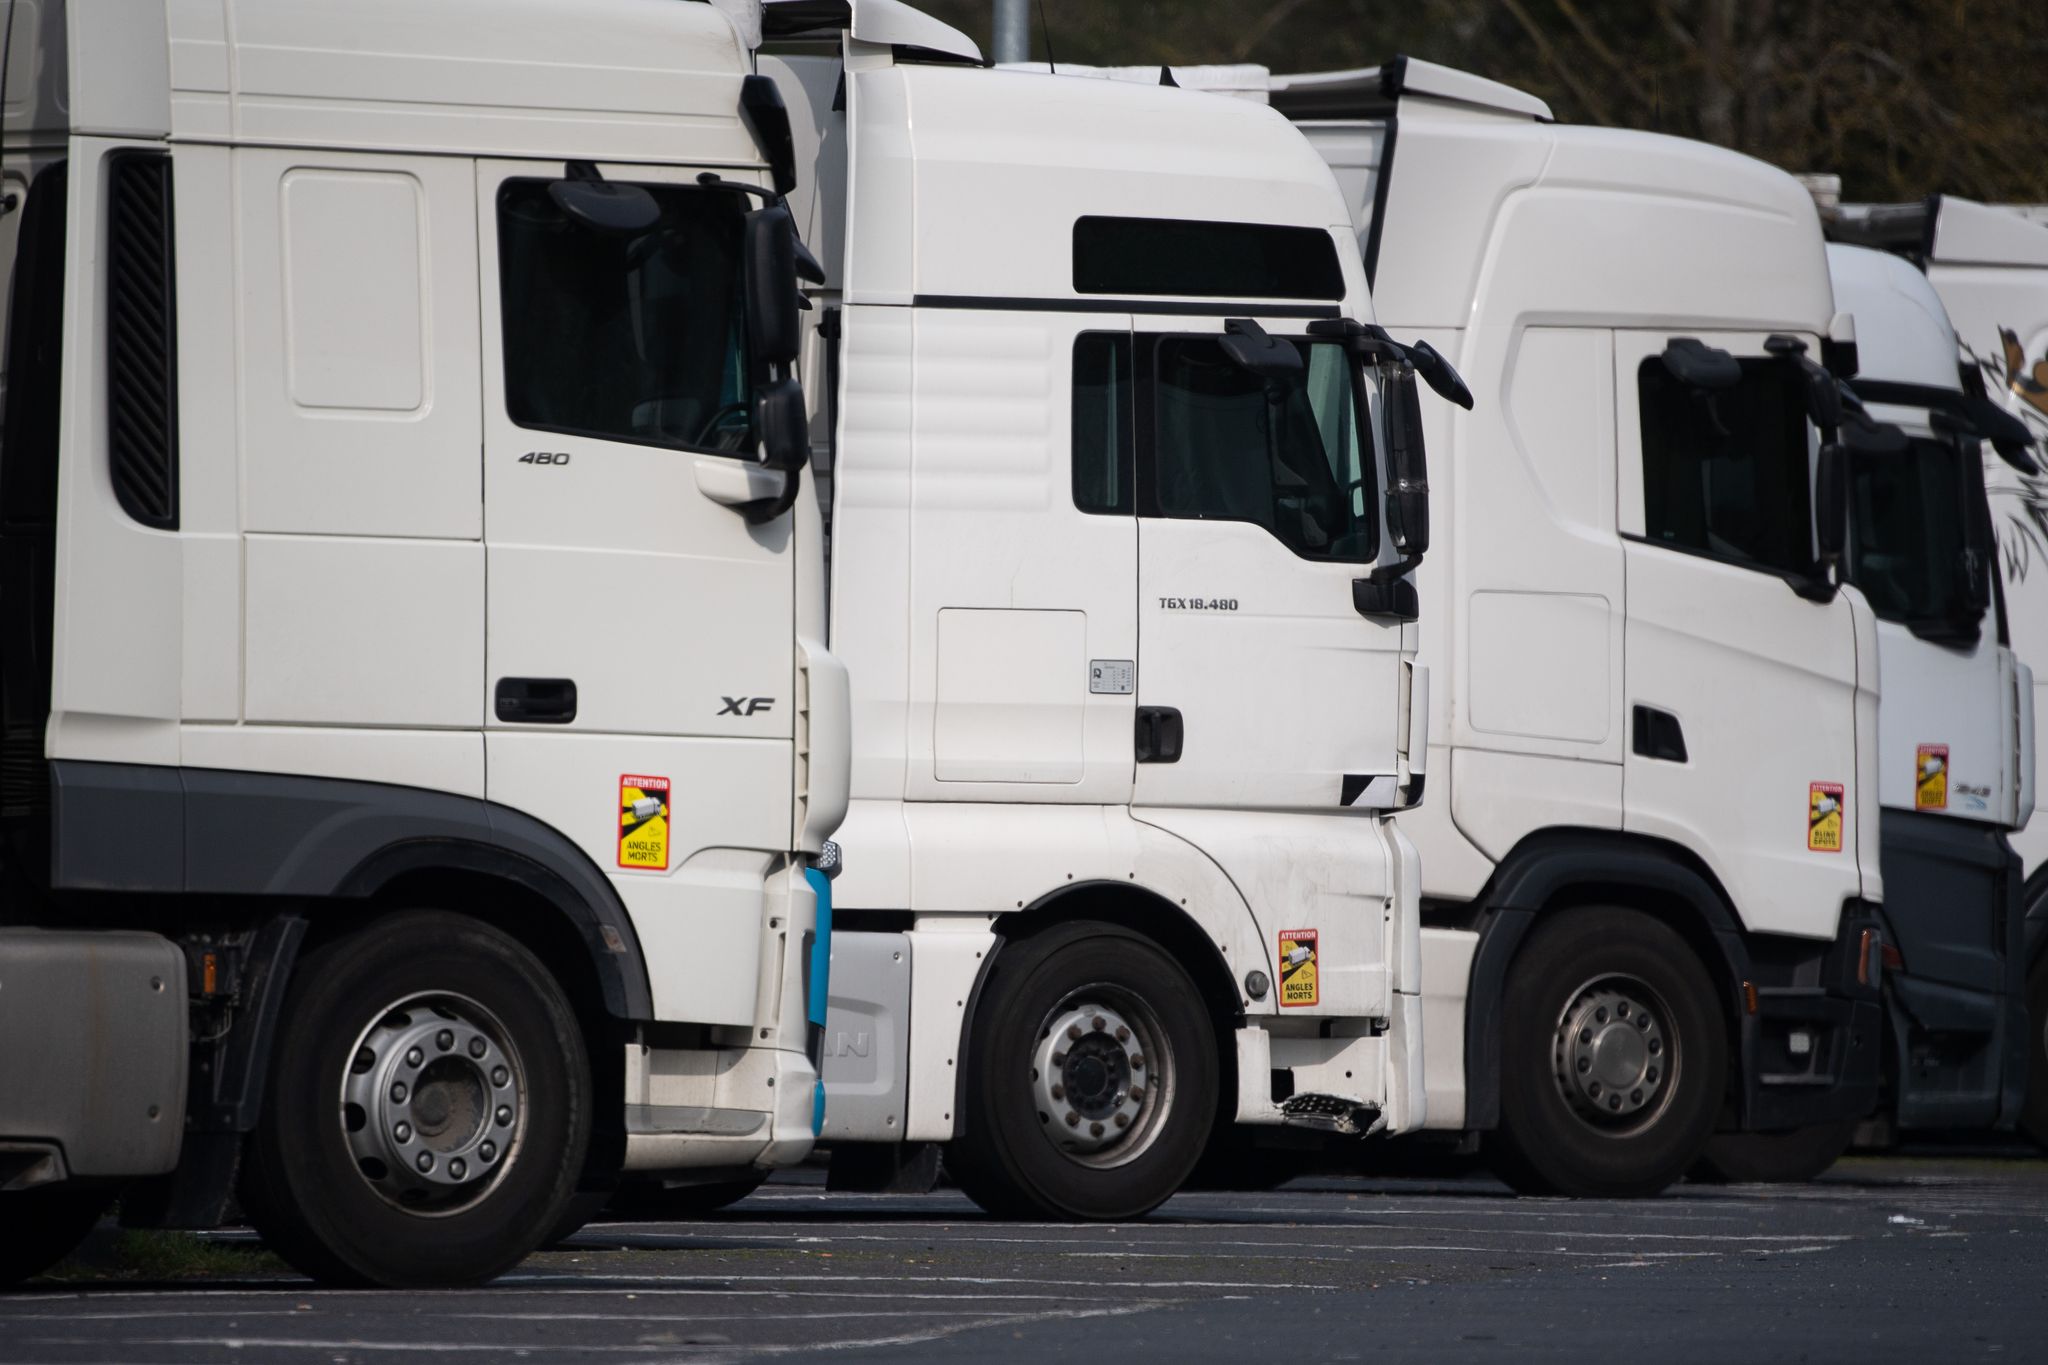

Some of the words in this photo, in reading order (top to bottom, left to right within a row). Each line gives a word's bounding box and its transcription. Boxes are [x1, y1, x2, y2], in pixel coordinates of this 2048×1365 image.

[518, 452, 570, 465] 480
[1159, 597, 1186, 609] TGX
[1189, 598, 1238, 610] 18.480
[717, 696, 775, 716] XF
[623, 777, 668, 789] ATTENTION
[627, 841, 661, 852] ANGLES
[628, 851, 658, 862] MORTS
[1281, 931, 1316, 940] ATTENTION
[1286, 983, 1313, 991] ANGLES
[1287, 991, 1312, 1000] MORTS
